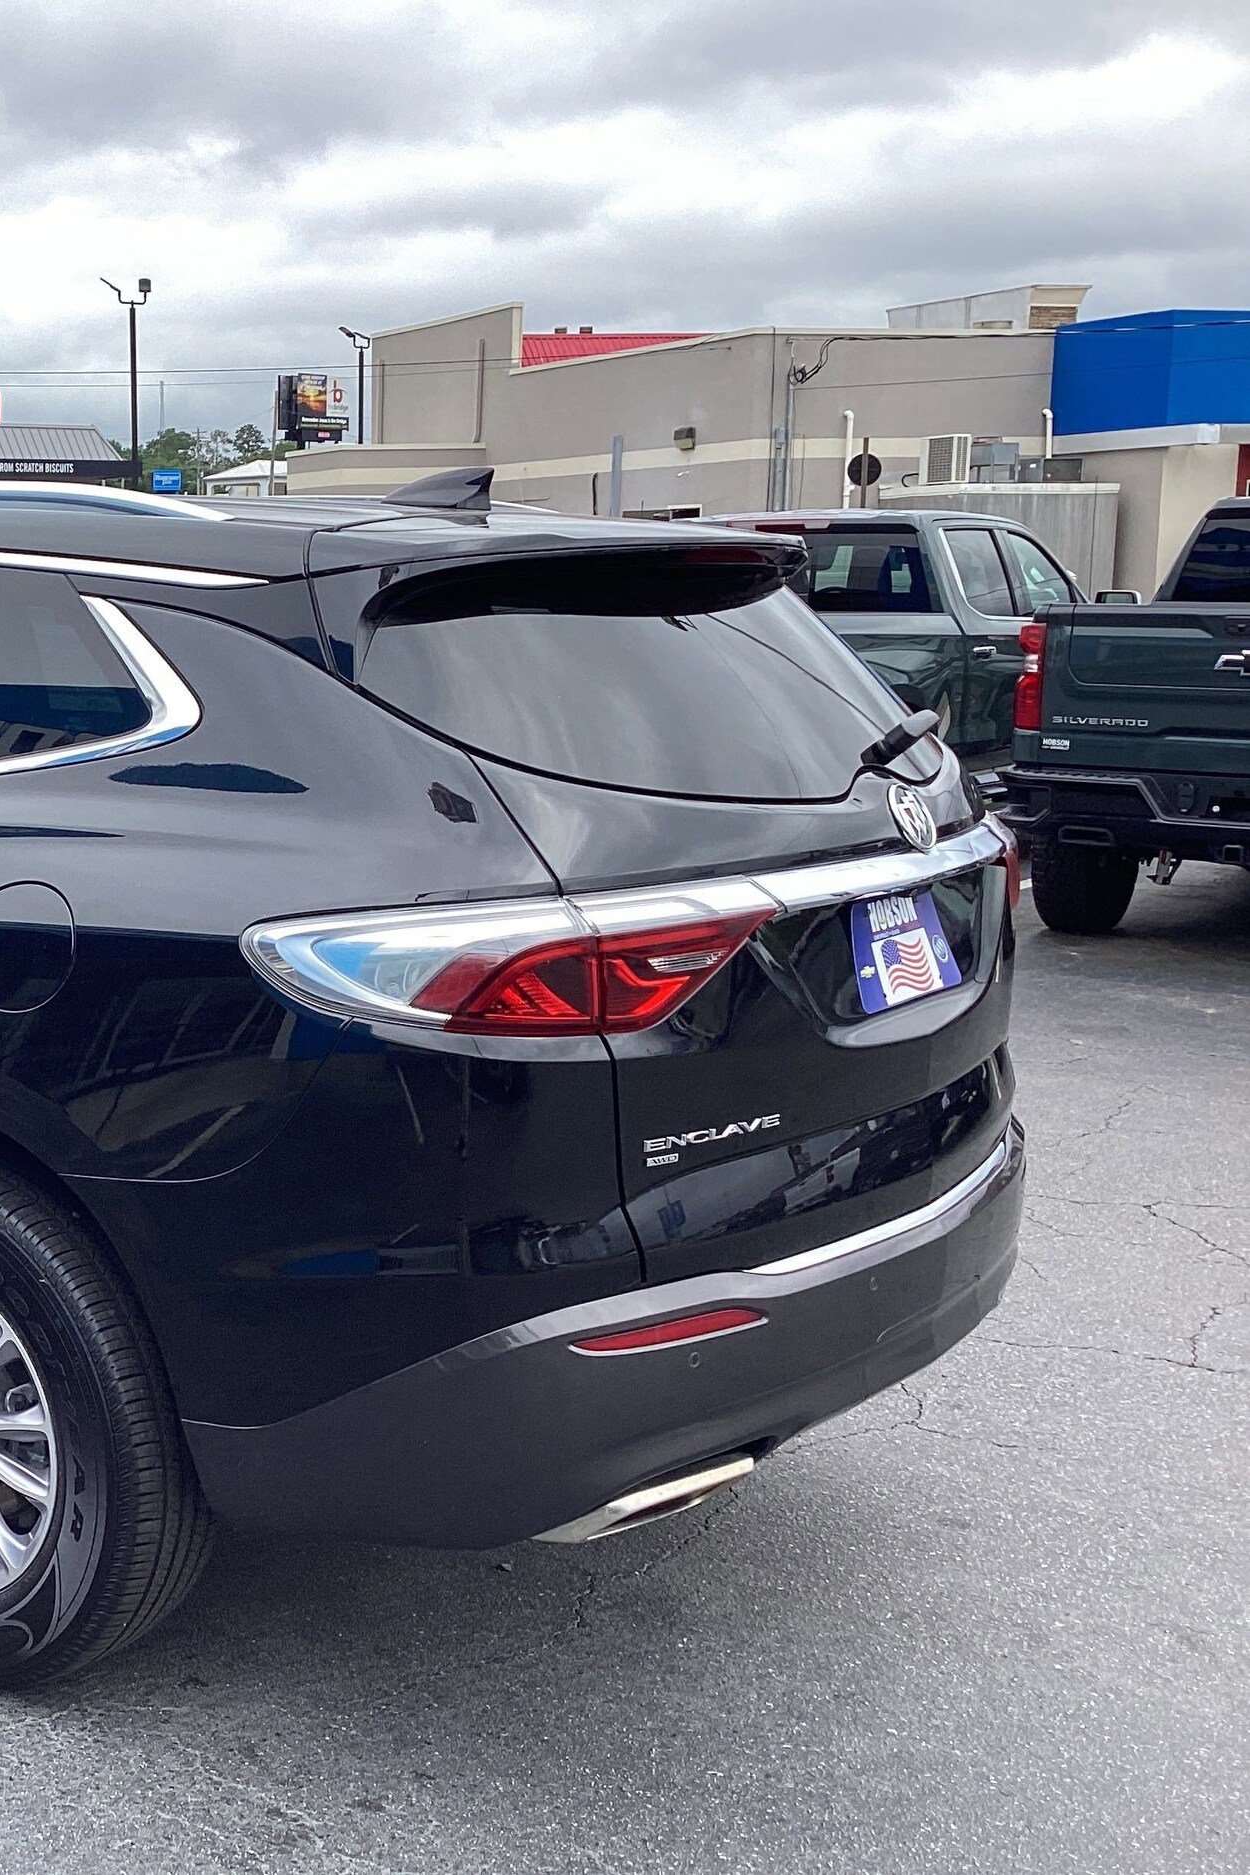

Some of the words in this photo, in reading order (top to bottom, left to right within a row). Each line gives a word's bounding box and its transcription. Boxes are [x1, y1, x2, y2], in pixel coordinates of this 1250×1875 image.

[15, 462, 44, 473] SCRATCH
[45, 463, 74, 473] BISCUITS
[1052, 715, 1149, 727] SILVERADO
[1042, 738, 1070, 747] HOBSON
[867, 896, 918, 933] HOBSON
[643, 1113, 781, 1153] ENCLAVE
[648, 1153, 679, 1167] AWD
